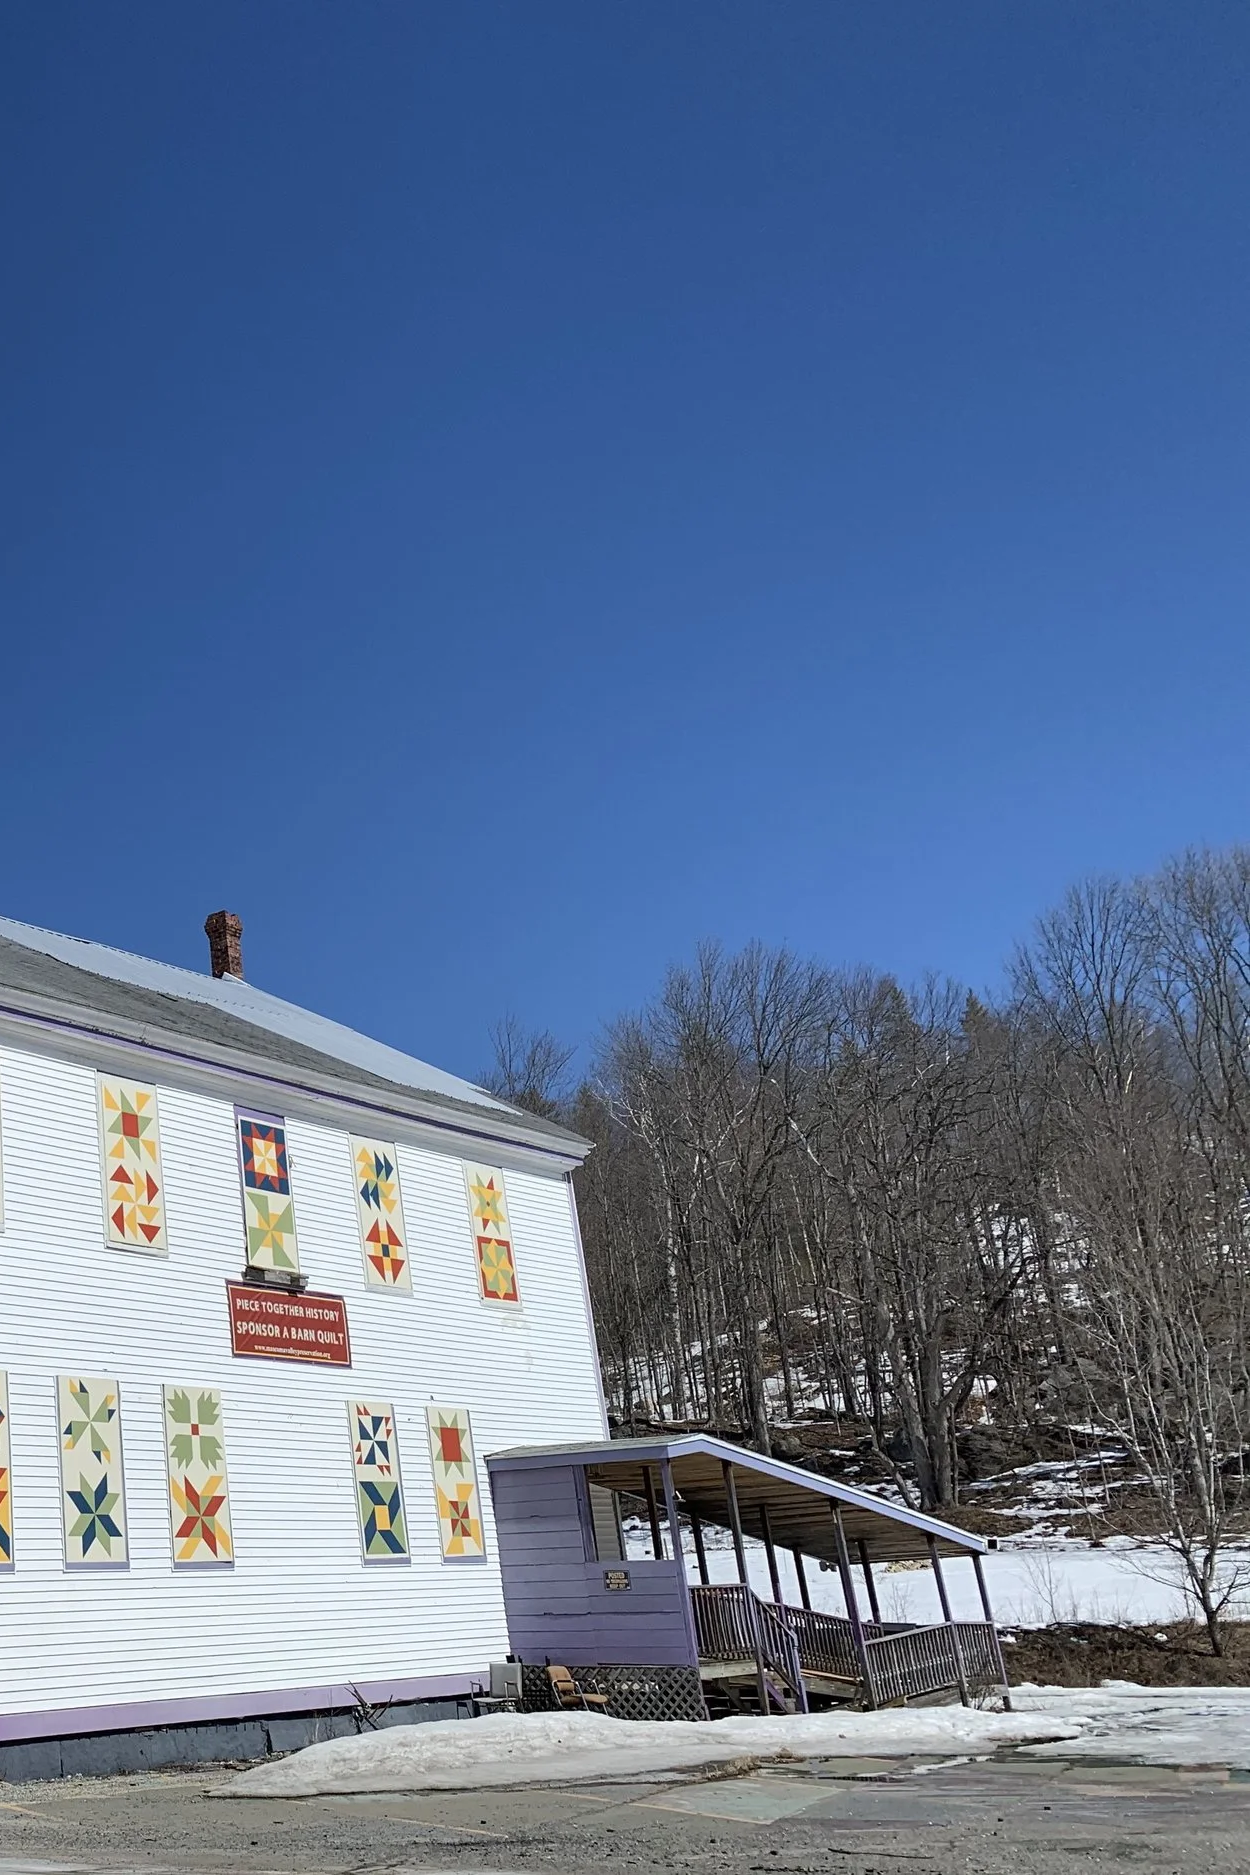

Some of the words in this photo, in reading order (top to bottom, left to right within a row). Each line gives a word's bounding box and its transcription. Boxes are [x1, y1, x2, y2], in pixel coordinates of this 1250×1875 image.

[236, 1298, 259, 1311] PIECE
[261, 1302, 304, 1317] TOGETHER
[305, 1307, 339, 1322] HISTORY
[236, 1321, 280, 1338] SPONSOR
[282, 1327, 289, 1339] A
[291, 1328, 315, 1342] BARN
[317, 1331, 344, 1345] QUILT
